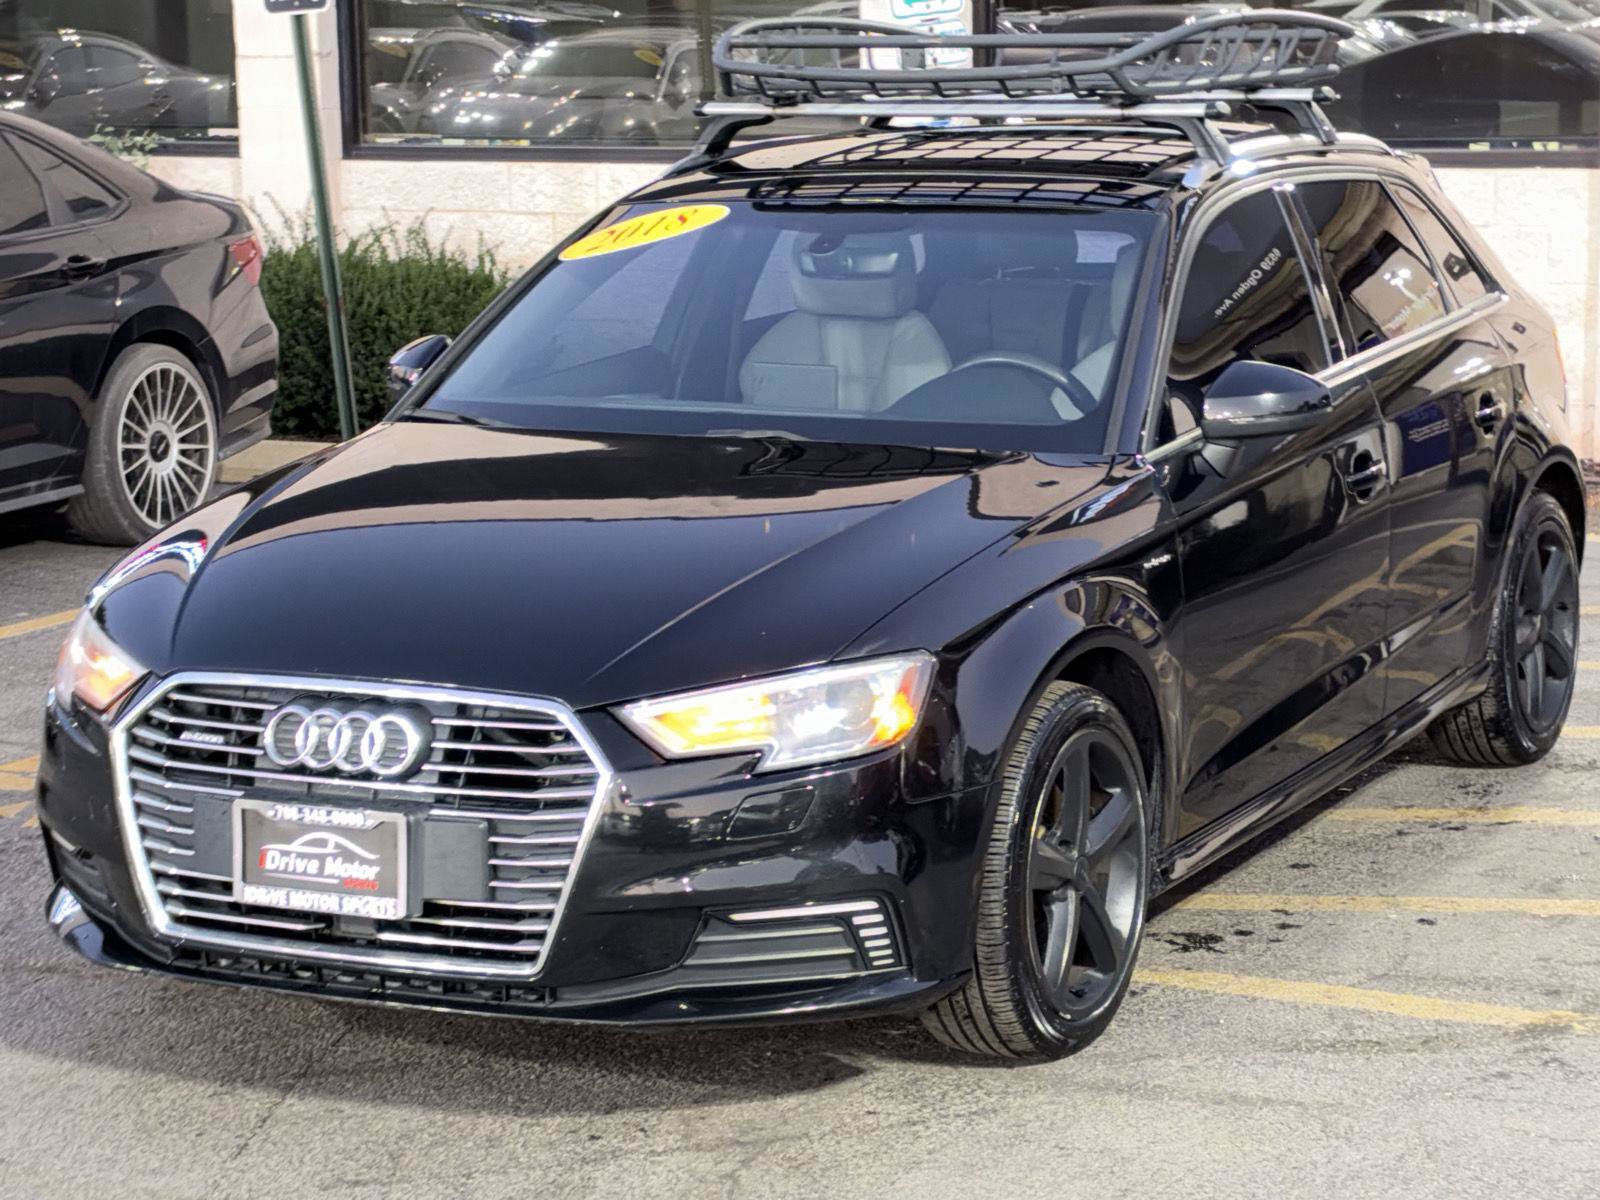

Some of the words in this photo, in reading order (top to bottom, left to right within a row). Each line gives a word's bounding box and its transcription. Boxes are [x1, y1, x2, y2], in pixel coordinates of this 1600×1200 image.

[323, 856, 381, 880] Motor
[289, 889, 340, 911] MOTOR
[341, 896, 396, 917] SPORTS
